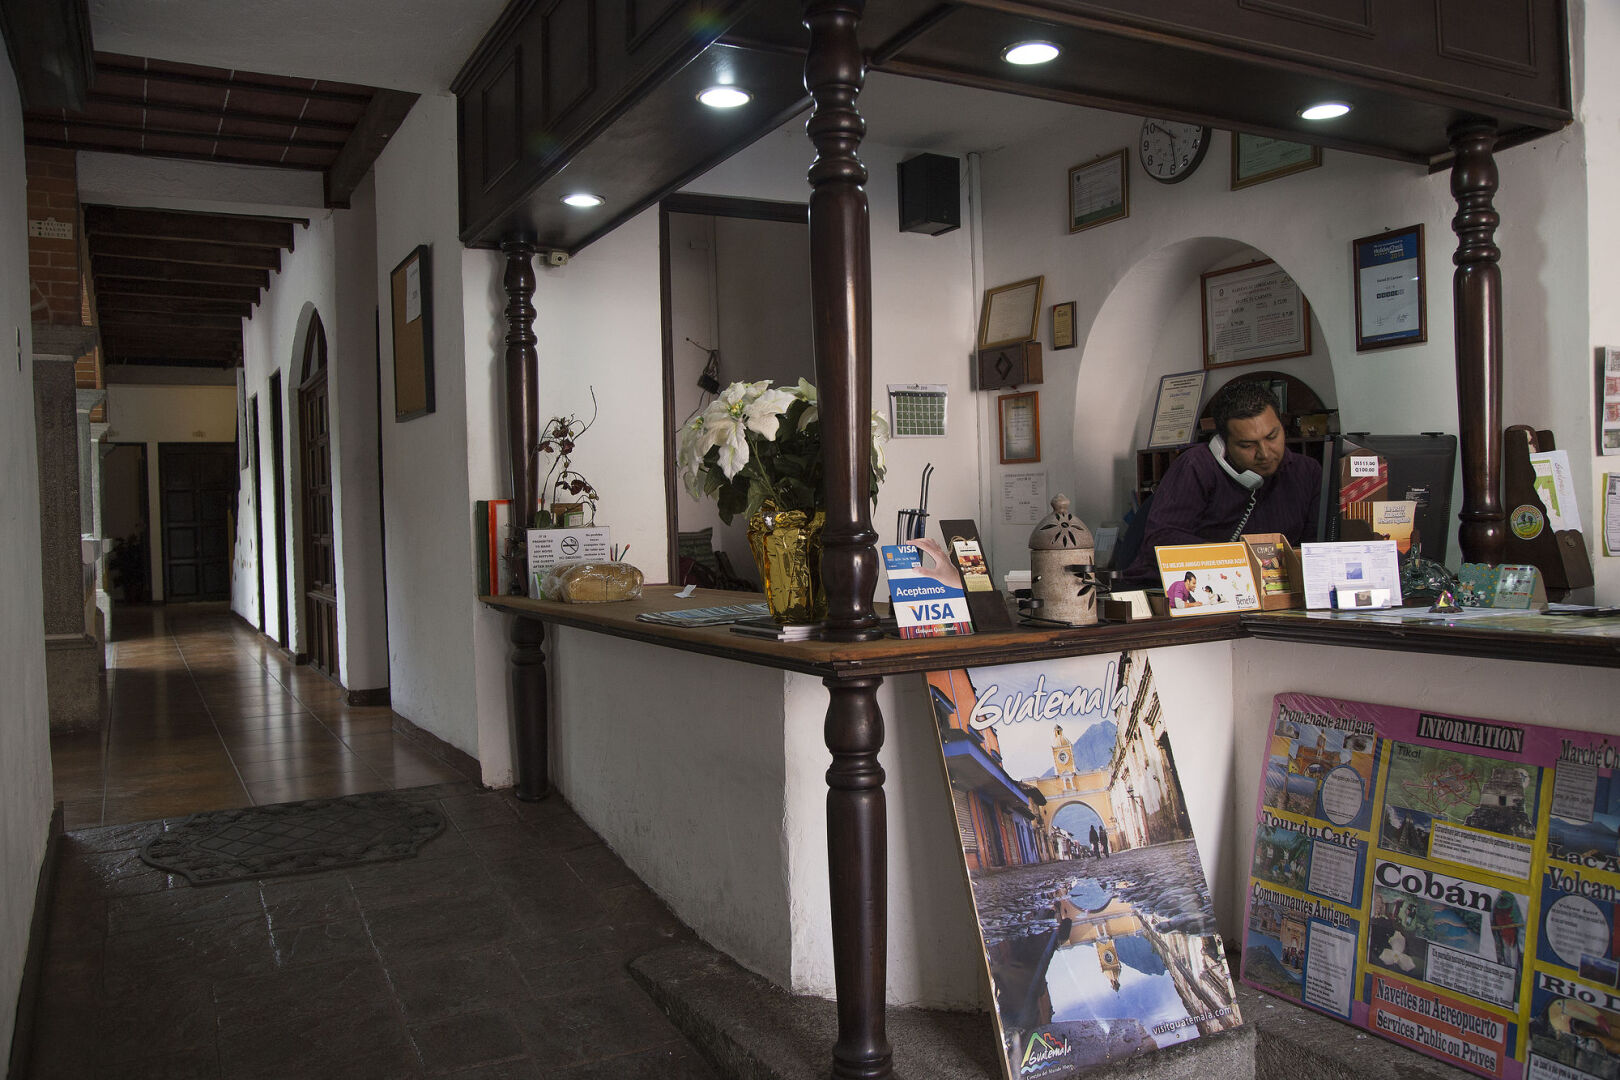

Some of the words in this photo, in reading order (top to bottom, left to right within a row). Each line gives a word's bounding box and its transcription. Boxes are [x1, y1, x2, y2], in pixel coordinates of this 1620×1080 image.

[1144, 122, 1155, 135] 10
[1143, 140, 1150, 151] 9
[1192, 139, 1199, 149] 4
[1147, 155, 1154, 166] 8
[1157, 162, 1164, 175] 7
[1169, 164, 1177, 175] 6
[1182, 154, 1189, 166] 5
[898, 545, 918, 554] VISA
[896, 586, 946, 598] Aceptamos
[1235, 595, 1257, 606] Beneful
[908, 602, 955, 622] VISA
[969, 661, 1129, 730] Guatemala
[1278, 703, 1334, 729] Promenade
[1334, 715, 1375, 735] antigua
[1420, 716, 1522, 752] INFORMATION
[1398, 745, 1421, 759] Tikal
[1560, 739, 1601, 767] Marché
[1263, 811, 1298, 833] Tour
[1299, 820, 1317, 839] du
[1321, 827, 1359, 849] Café
[1548, 844, 1598, 868] Lac
[1376, 862, 1493, 912] Cobán
[1253, 882, 1314, 916] Communautes
[1314, 900, 1351, 928] Antigua
[1542, 973, 1596, 1003] Rio
[1153, 1007, 1233, 1034] visitguatemala.com
[1376, 978, 1418, 1012] Navettes
[1419, 997, 1431, 1017] au
[1432, 998, 1498, 1040] Aereopuerto
[1028, 1038, 1073, 1066] Guatemala
[1377, 1009, 1415, 1039] Services
[1416, 1024, 1447, 1053] Public
[1448, 1041, 1460, 1057] ou
[1461, 1041, 1497, 1071] Prives
